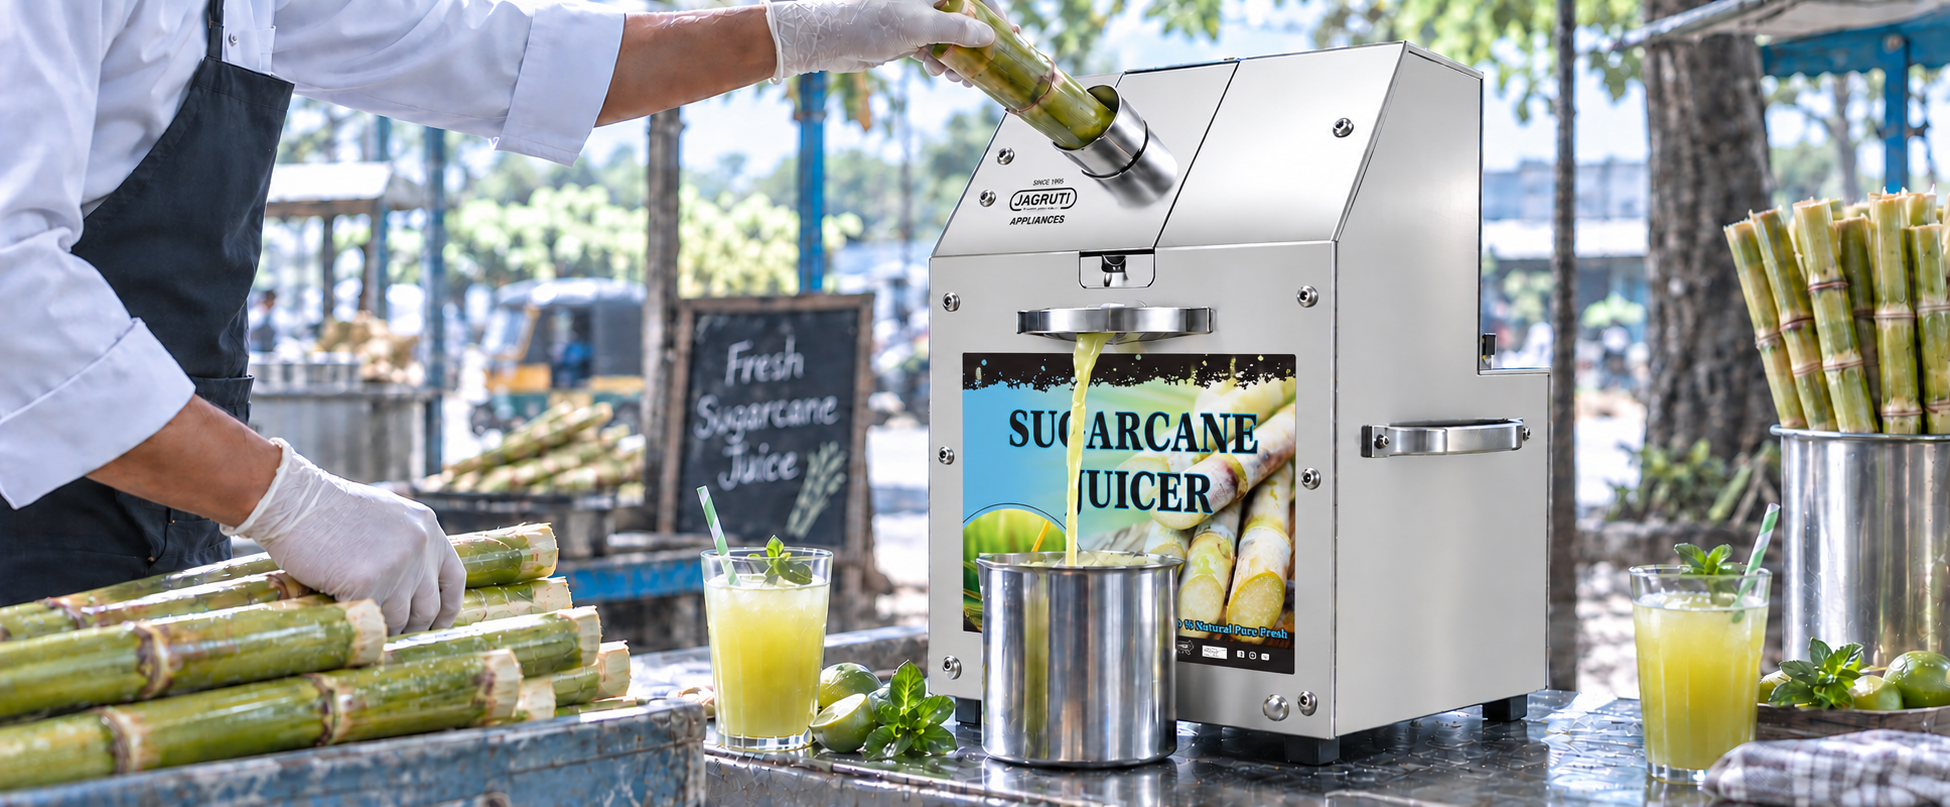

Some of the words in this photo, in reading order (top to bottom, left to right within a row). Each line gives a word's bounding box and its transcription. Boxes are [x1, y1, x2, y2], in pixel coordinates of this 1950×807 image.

[1014, 192, 1071, 206] JAGRUTI
[1009, 215, 1065, 225] APPLIANCES
[725, 335, 804, 386] Fresh
[693, 394, 840, 444] Sugarcane
[717, 442, 800, 491] Juice
[1195, 620, 1232, 634] Natural
[1234, 624, 1258, 637] Pure
[1259, 626, 1288, 639] Fresh
